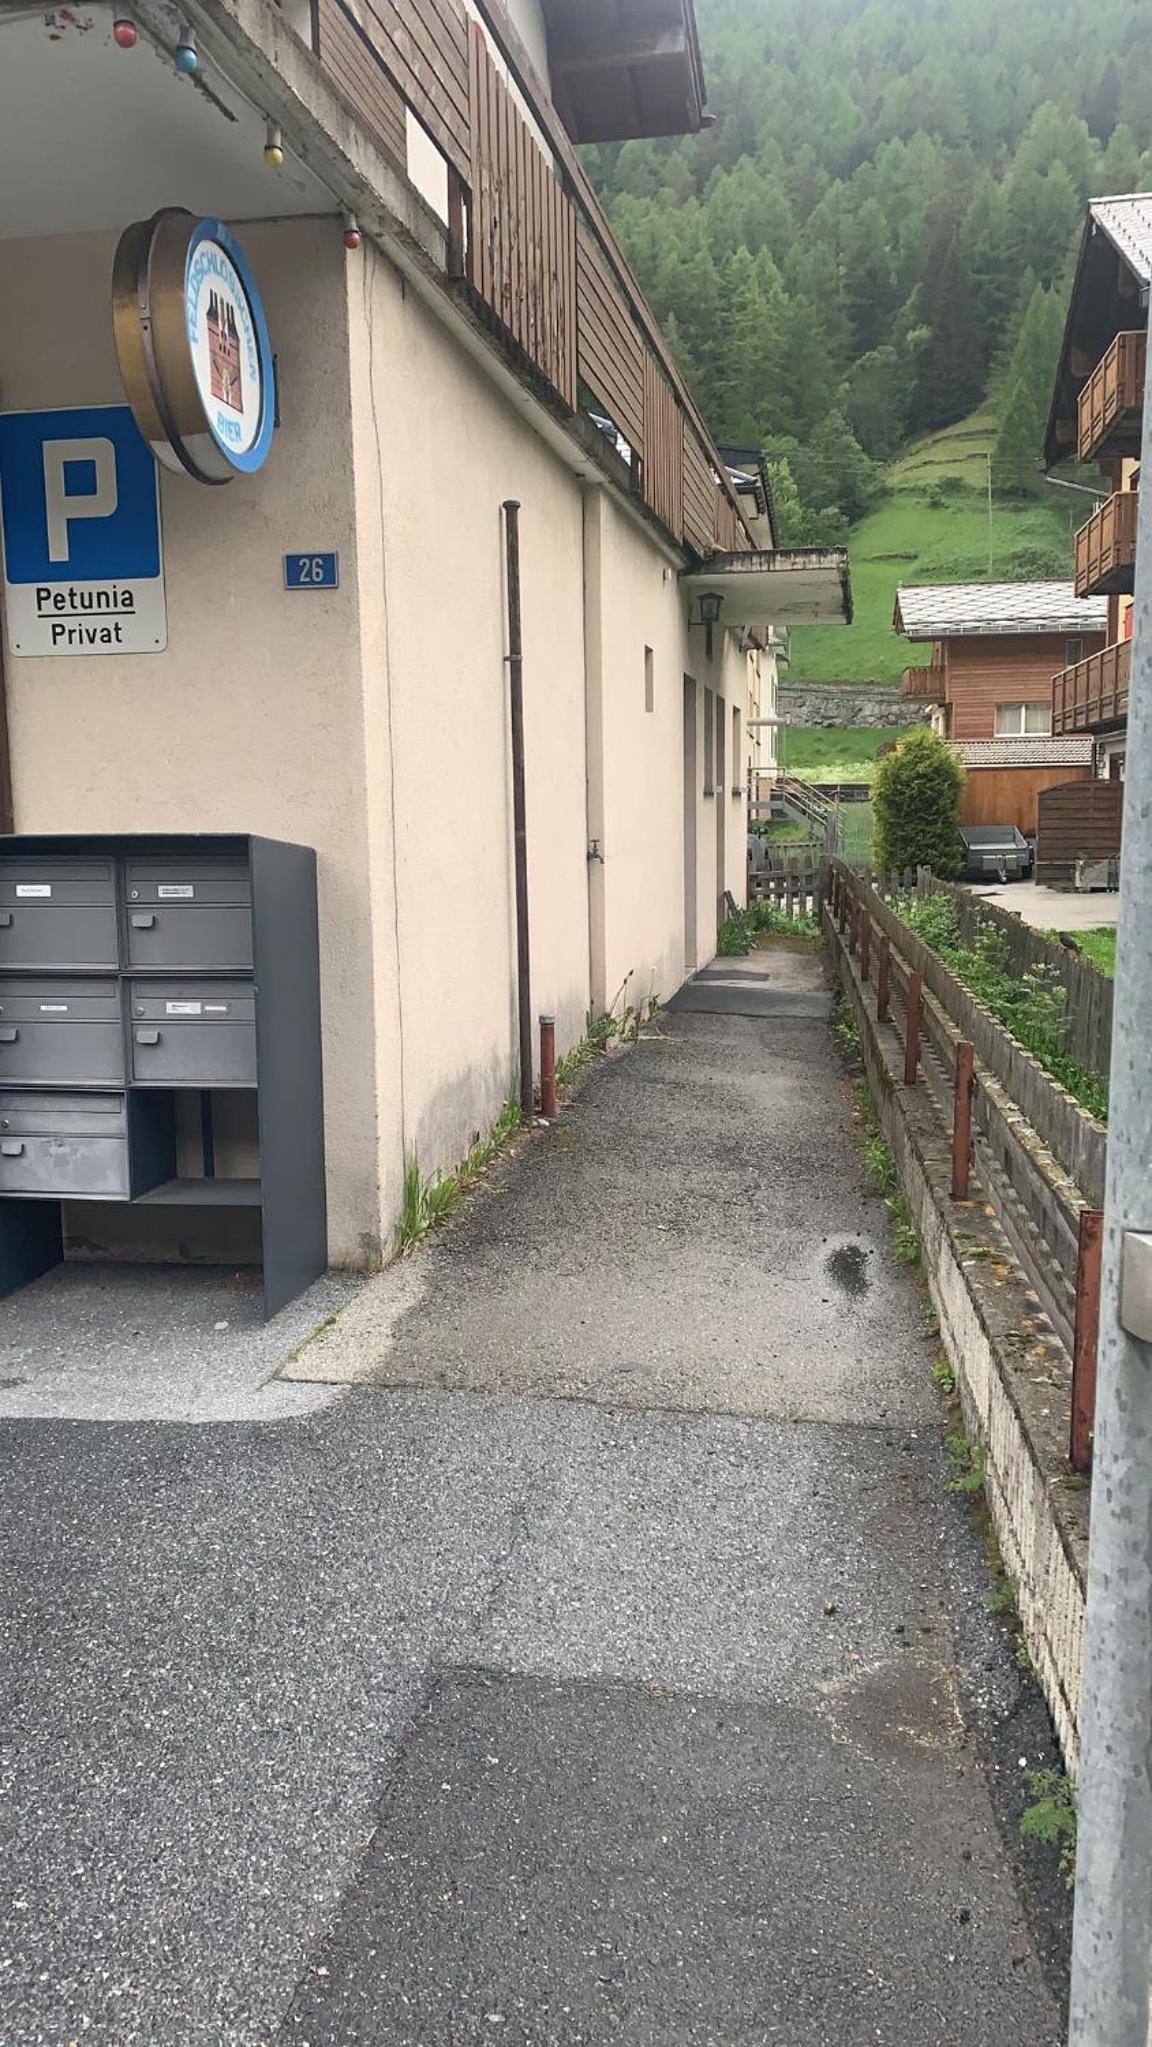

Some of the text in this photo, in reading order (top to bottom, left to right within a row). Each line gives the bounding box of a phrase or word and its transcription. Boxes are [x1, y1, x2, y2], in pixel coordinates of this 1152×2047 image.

[217, 413, 242, 443] BIER
[42, 437, 118, 562] P
[299, 558, 323, 581] 26
[36, 585, 134, 611] Petunia
[51, 622, 122, 645] Privat
